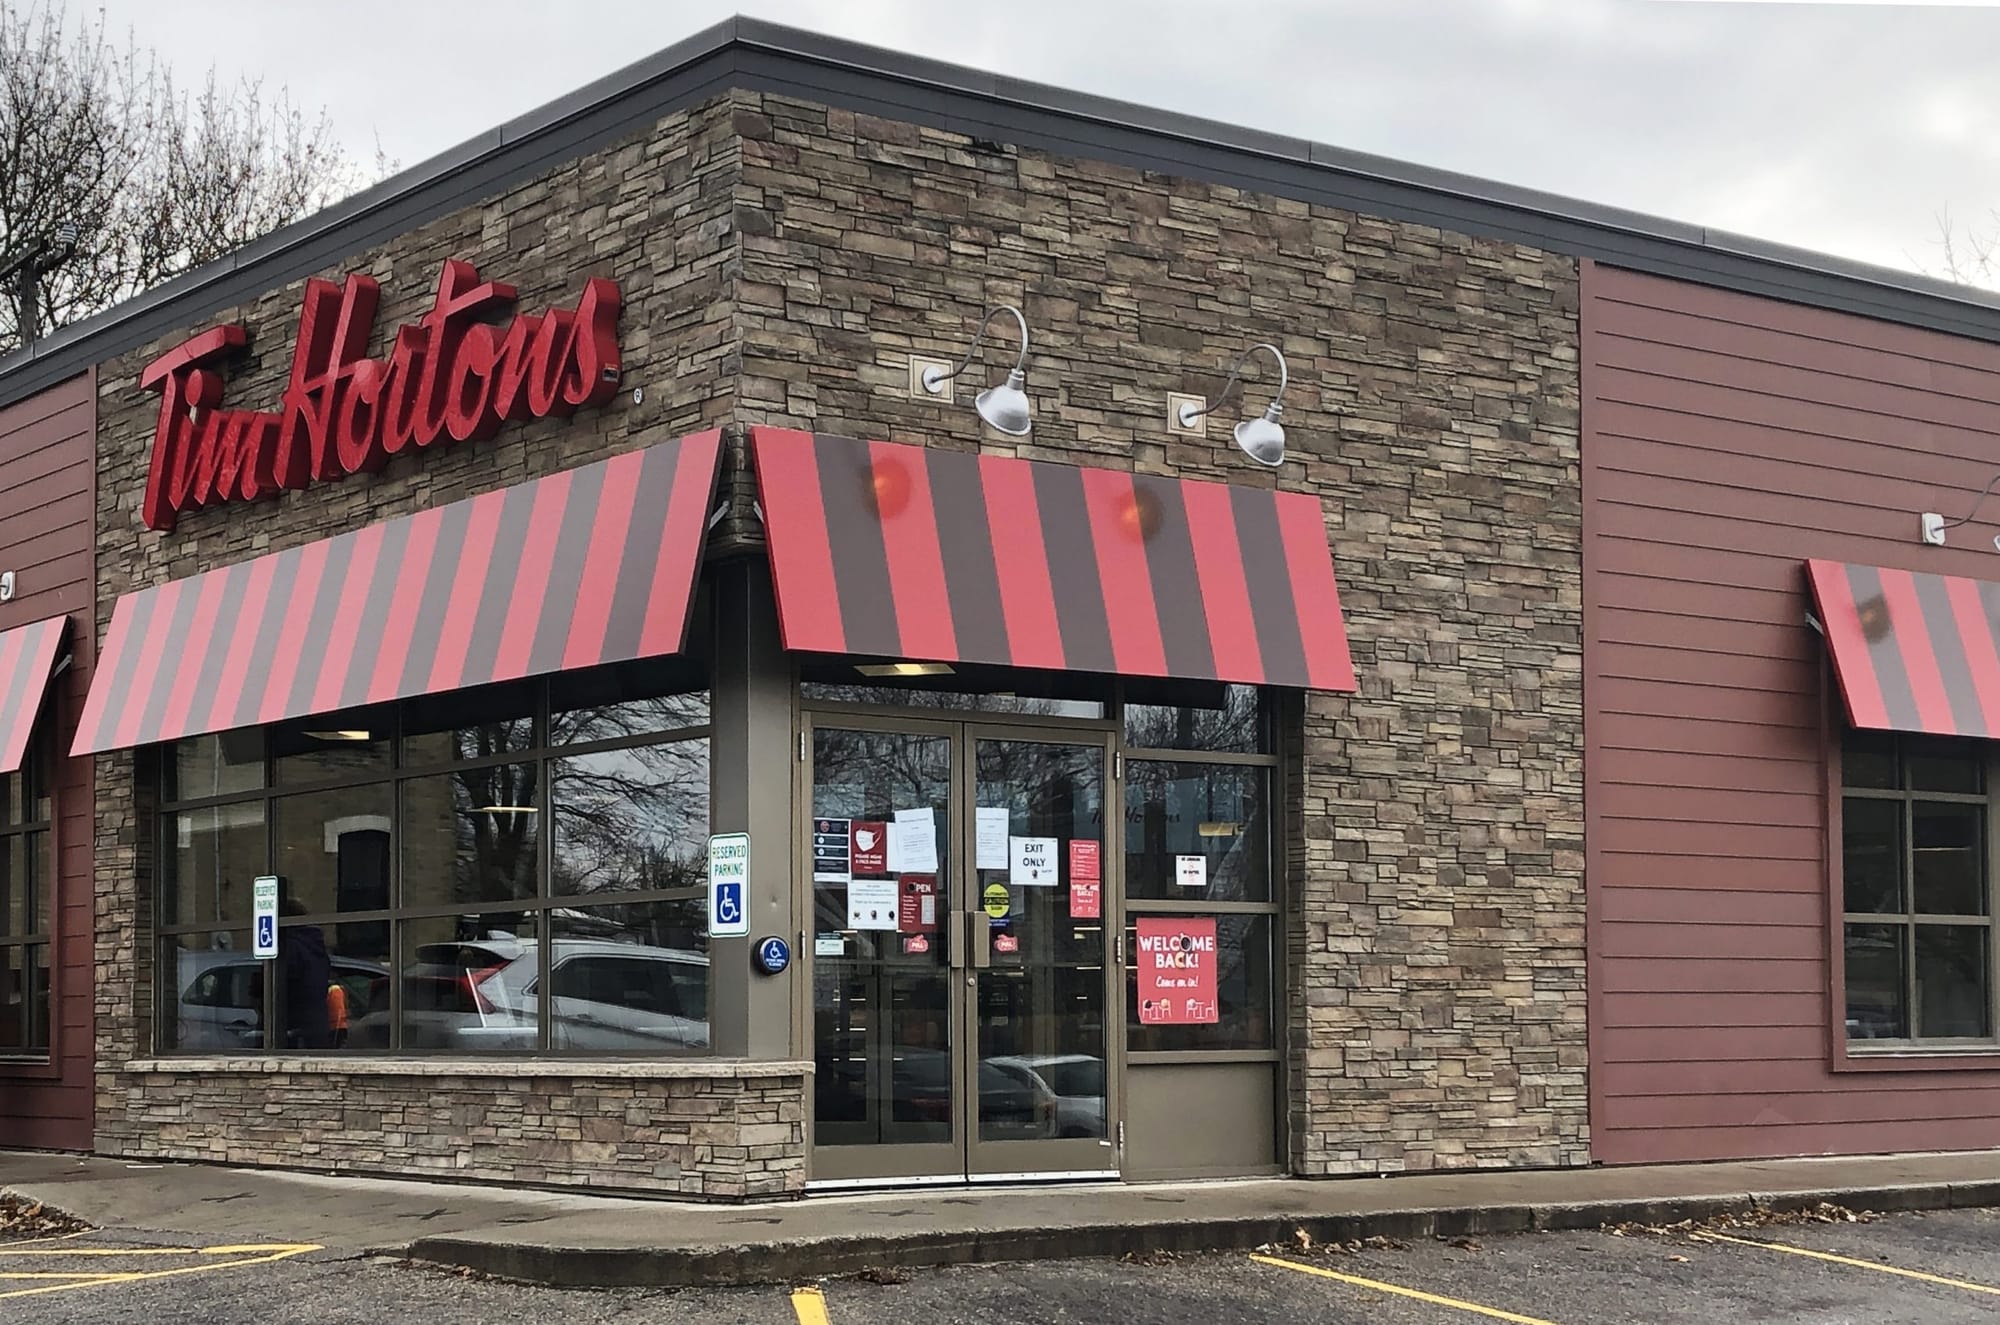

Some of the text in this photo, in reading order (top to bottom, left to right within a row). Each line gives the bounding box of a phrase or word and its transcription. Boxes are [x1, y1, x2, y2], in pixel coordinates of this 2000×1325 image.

[140, 325, 286, 530] Tim
[273, 257, 622, 490] Hortons
[712, 845, 746, 859] RESERVED
[1024, 843, 1044, 853] EXIT
[1022, 857, 1046, 867] ONLY
[714, 862, 744, 877] PARKING
[1139, 933, 1214, 952] WELCOME
[1155, 951, 1199, 969] BACK!
[1156, 975, 1176, 988] Come
[1176, 978, 1187, 988] on
